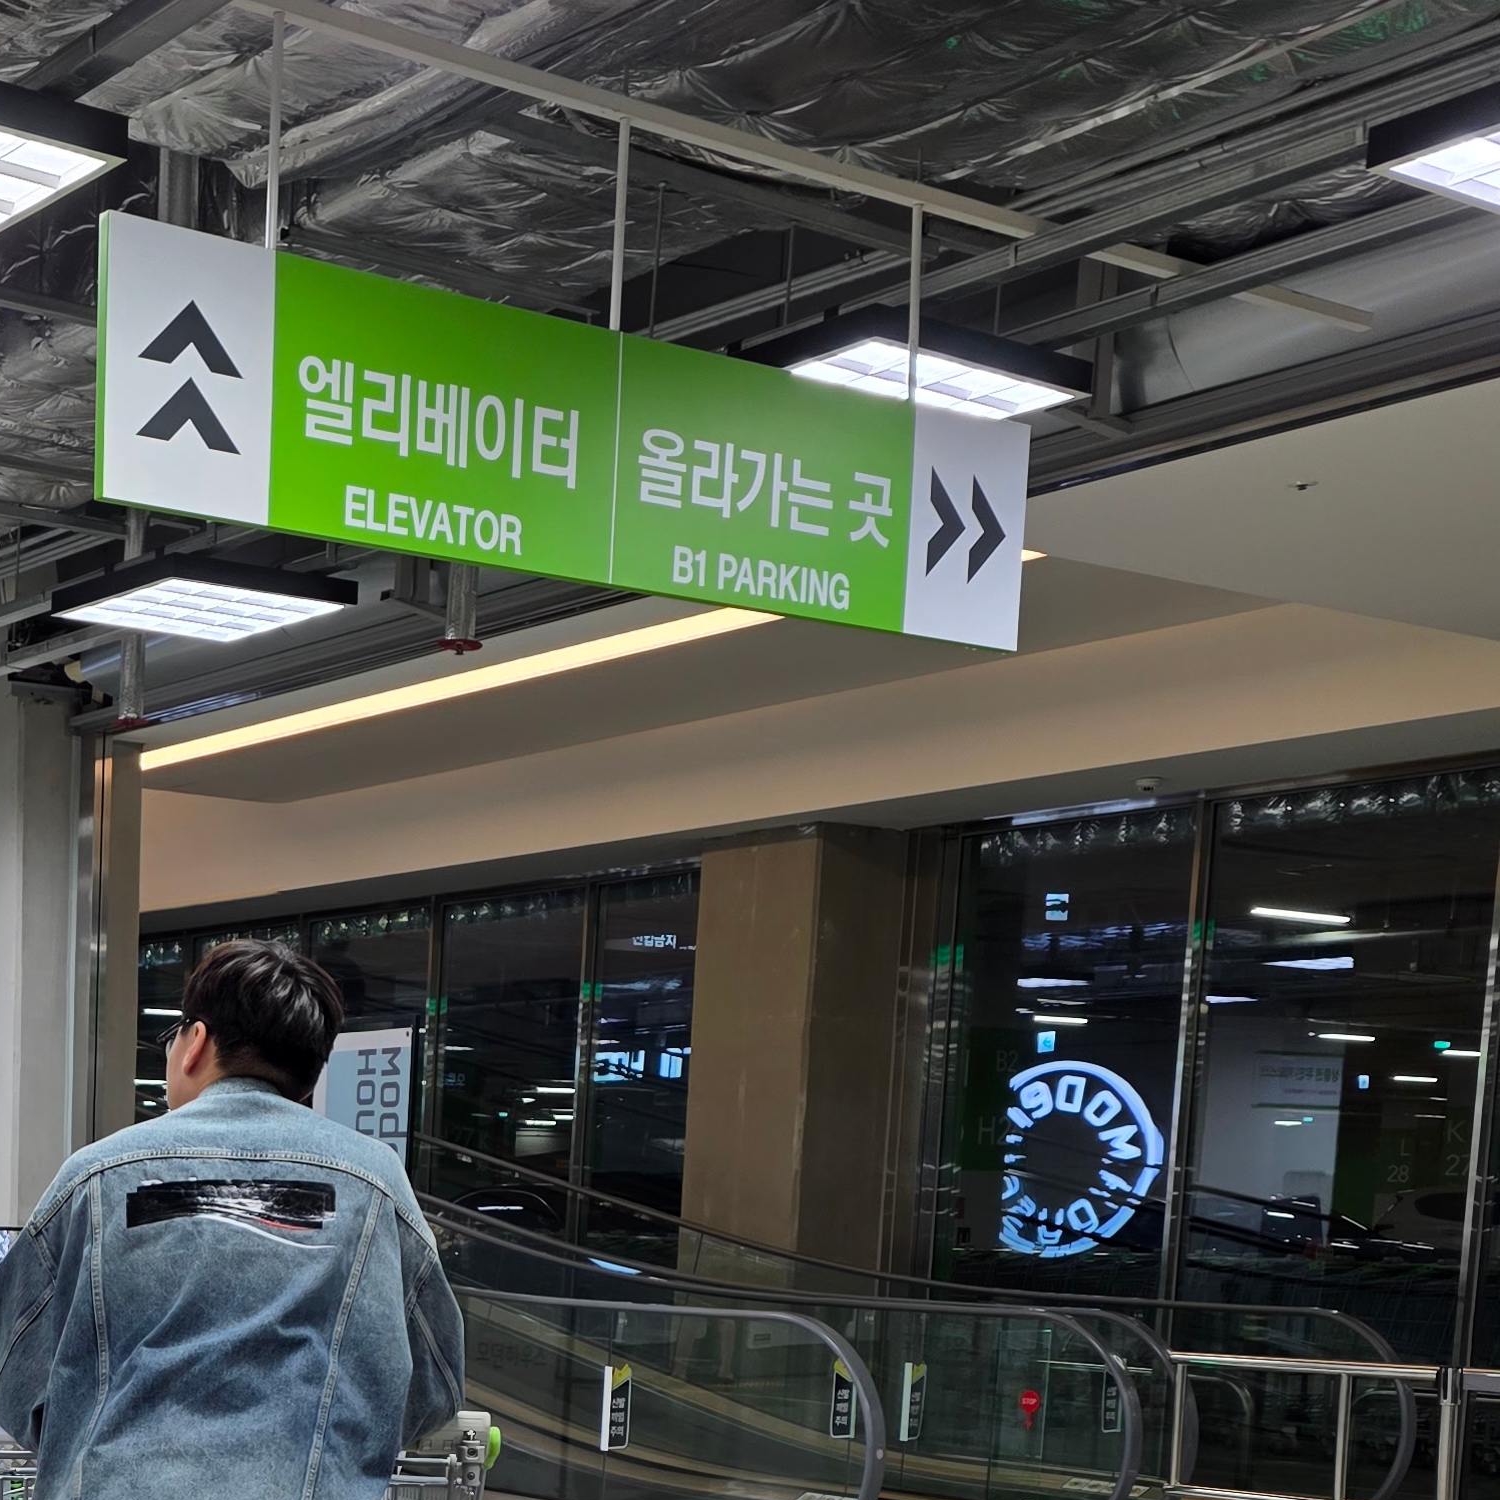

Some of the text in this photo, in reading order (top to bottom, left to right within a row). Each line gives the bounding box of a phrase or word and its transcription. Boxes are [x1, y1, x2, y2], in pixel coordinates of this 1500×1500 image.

[298, 354, 581, 491] 엘리베이터
[344, 485, 524, 557] ELEVATOR
[637, 427, 894, 549] 올라가는 곳
[673, 546, 851, 611] B1 PARKING
[379, 1047, 407, 1153] Mod
